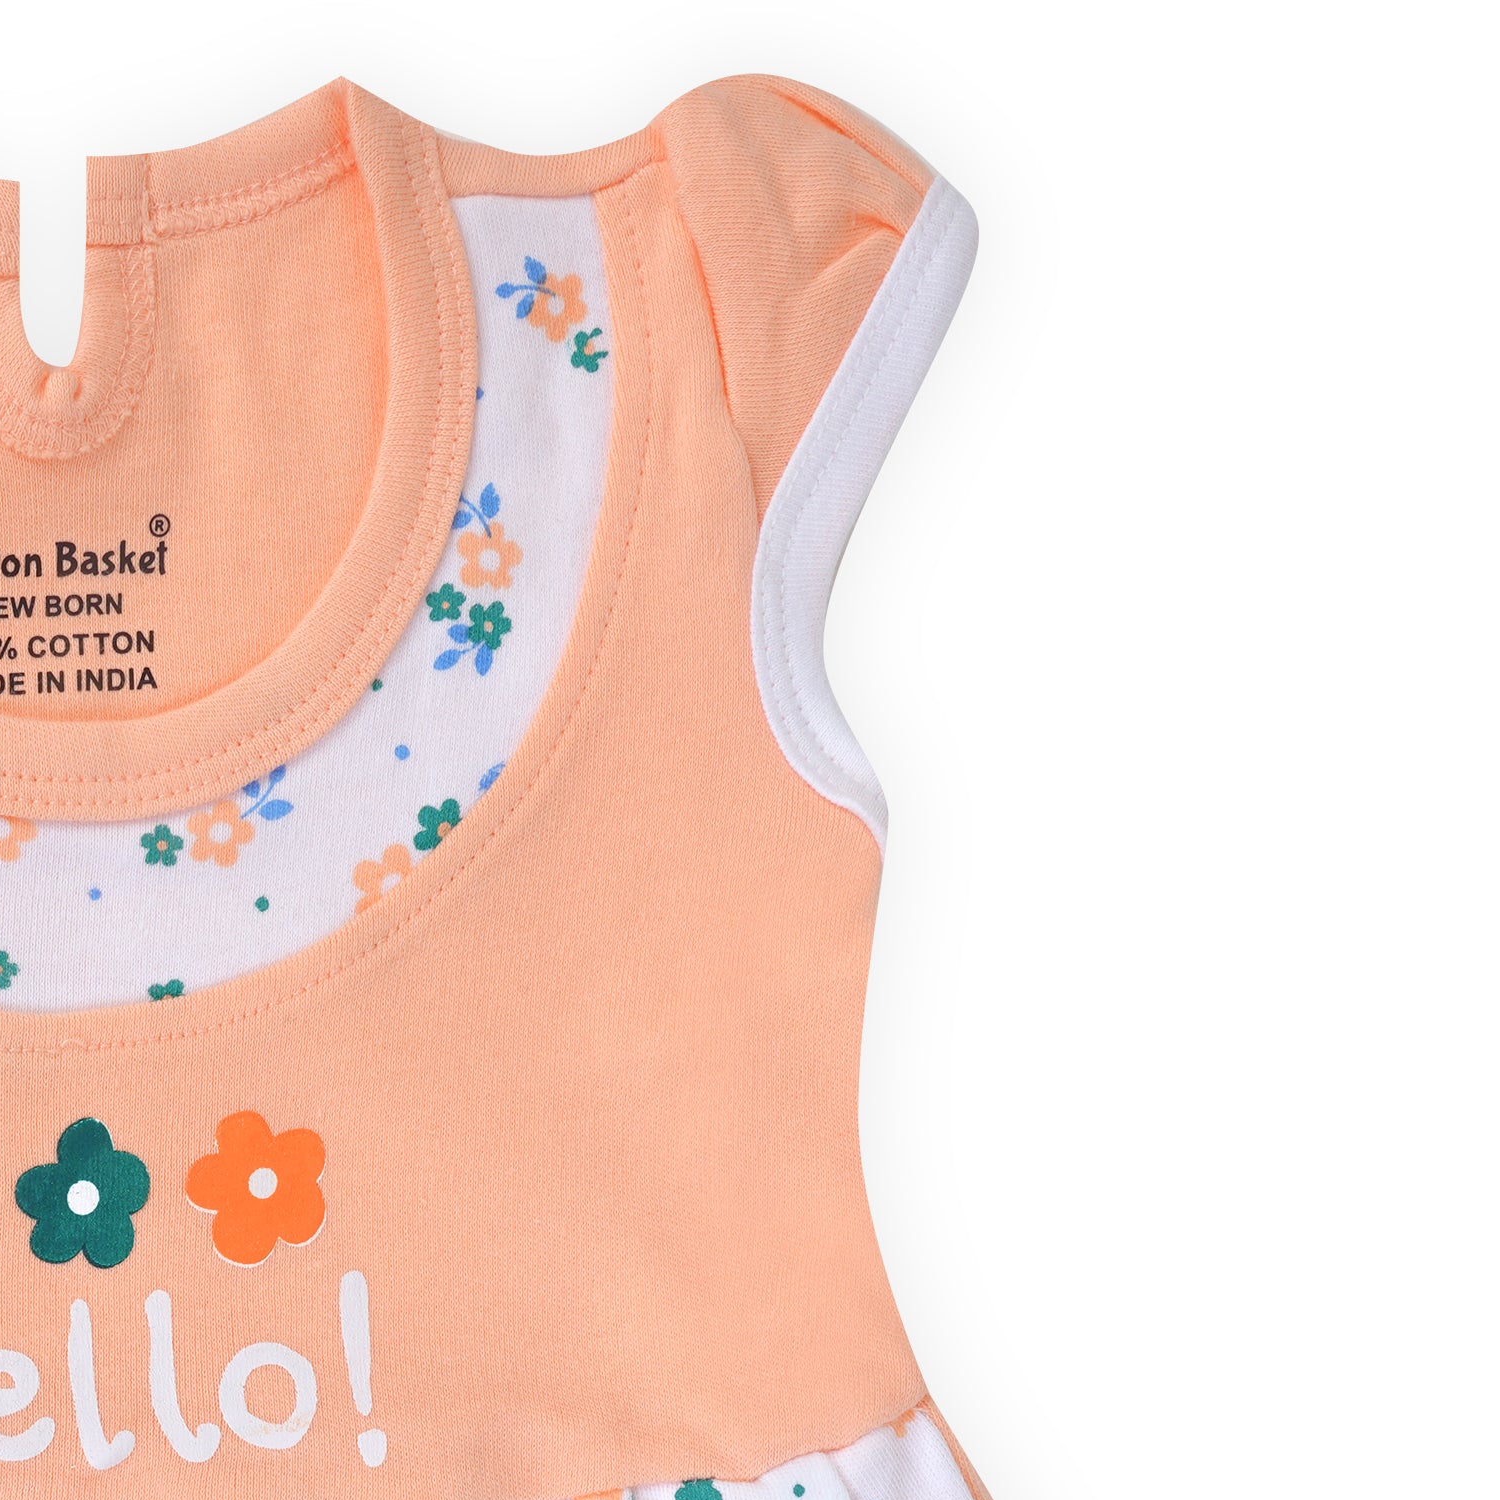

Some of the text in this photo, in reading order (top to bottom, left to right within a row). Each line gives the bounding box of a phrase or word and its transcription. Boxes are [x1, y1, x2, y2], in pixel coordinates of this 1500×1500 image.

[55, 540, 167, 577] Basket
[45, 593, 122, 617] BORN
[28, 631, 154, 658] COTTON
[38, 671, 64, 693] IN
[77, 667, 157, 691] INDIA
